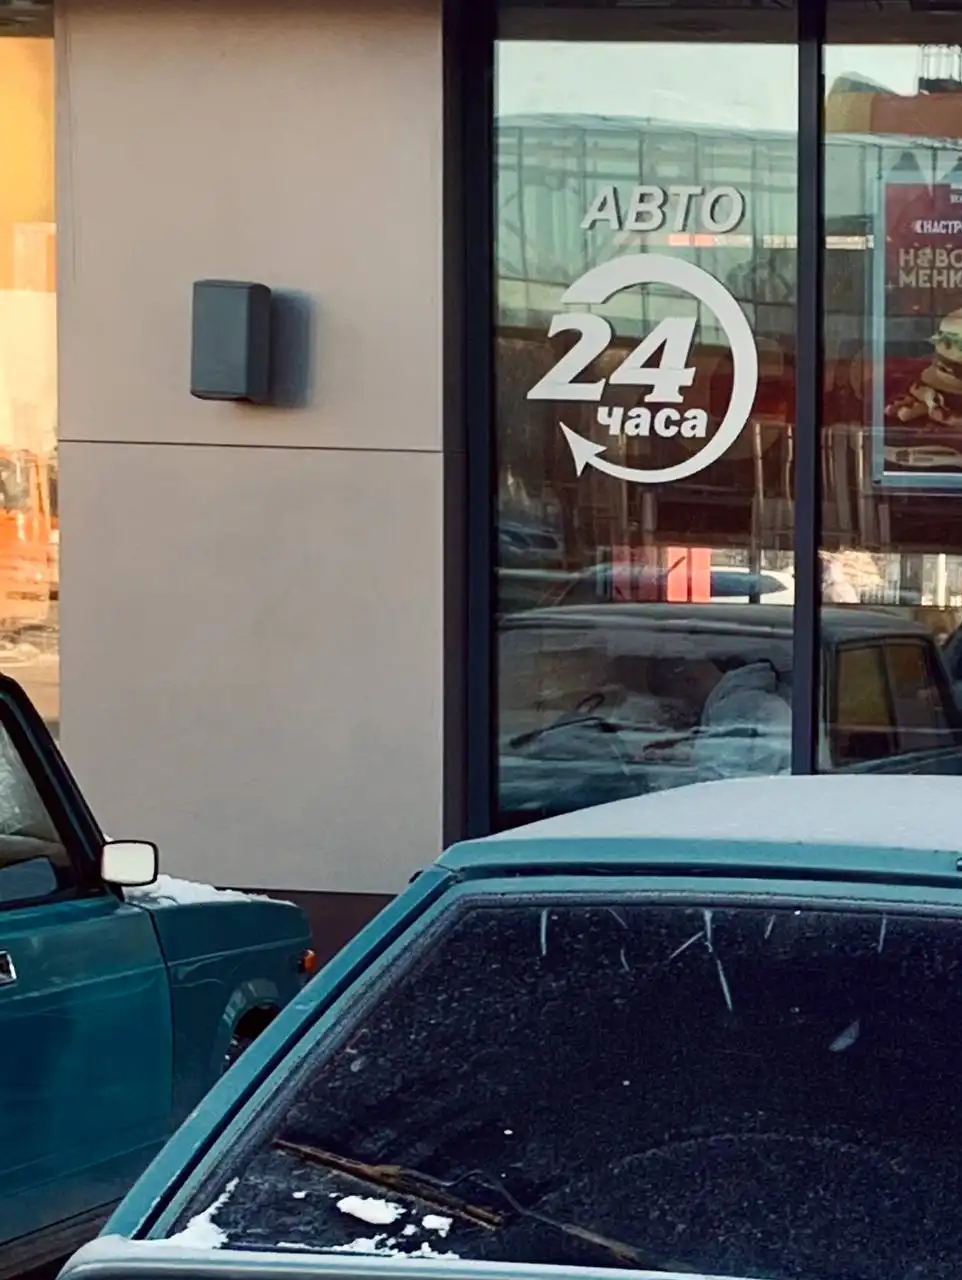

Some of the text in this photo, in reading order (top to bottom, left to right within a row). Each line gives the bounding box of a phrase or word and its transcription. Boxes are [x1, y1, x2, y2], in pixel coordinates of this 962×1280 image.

[580, 185, 745, 233] АВТО
[526, 312, 698, 403] 24
[596, 406, 708, 438] часа
